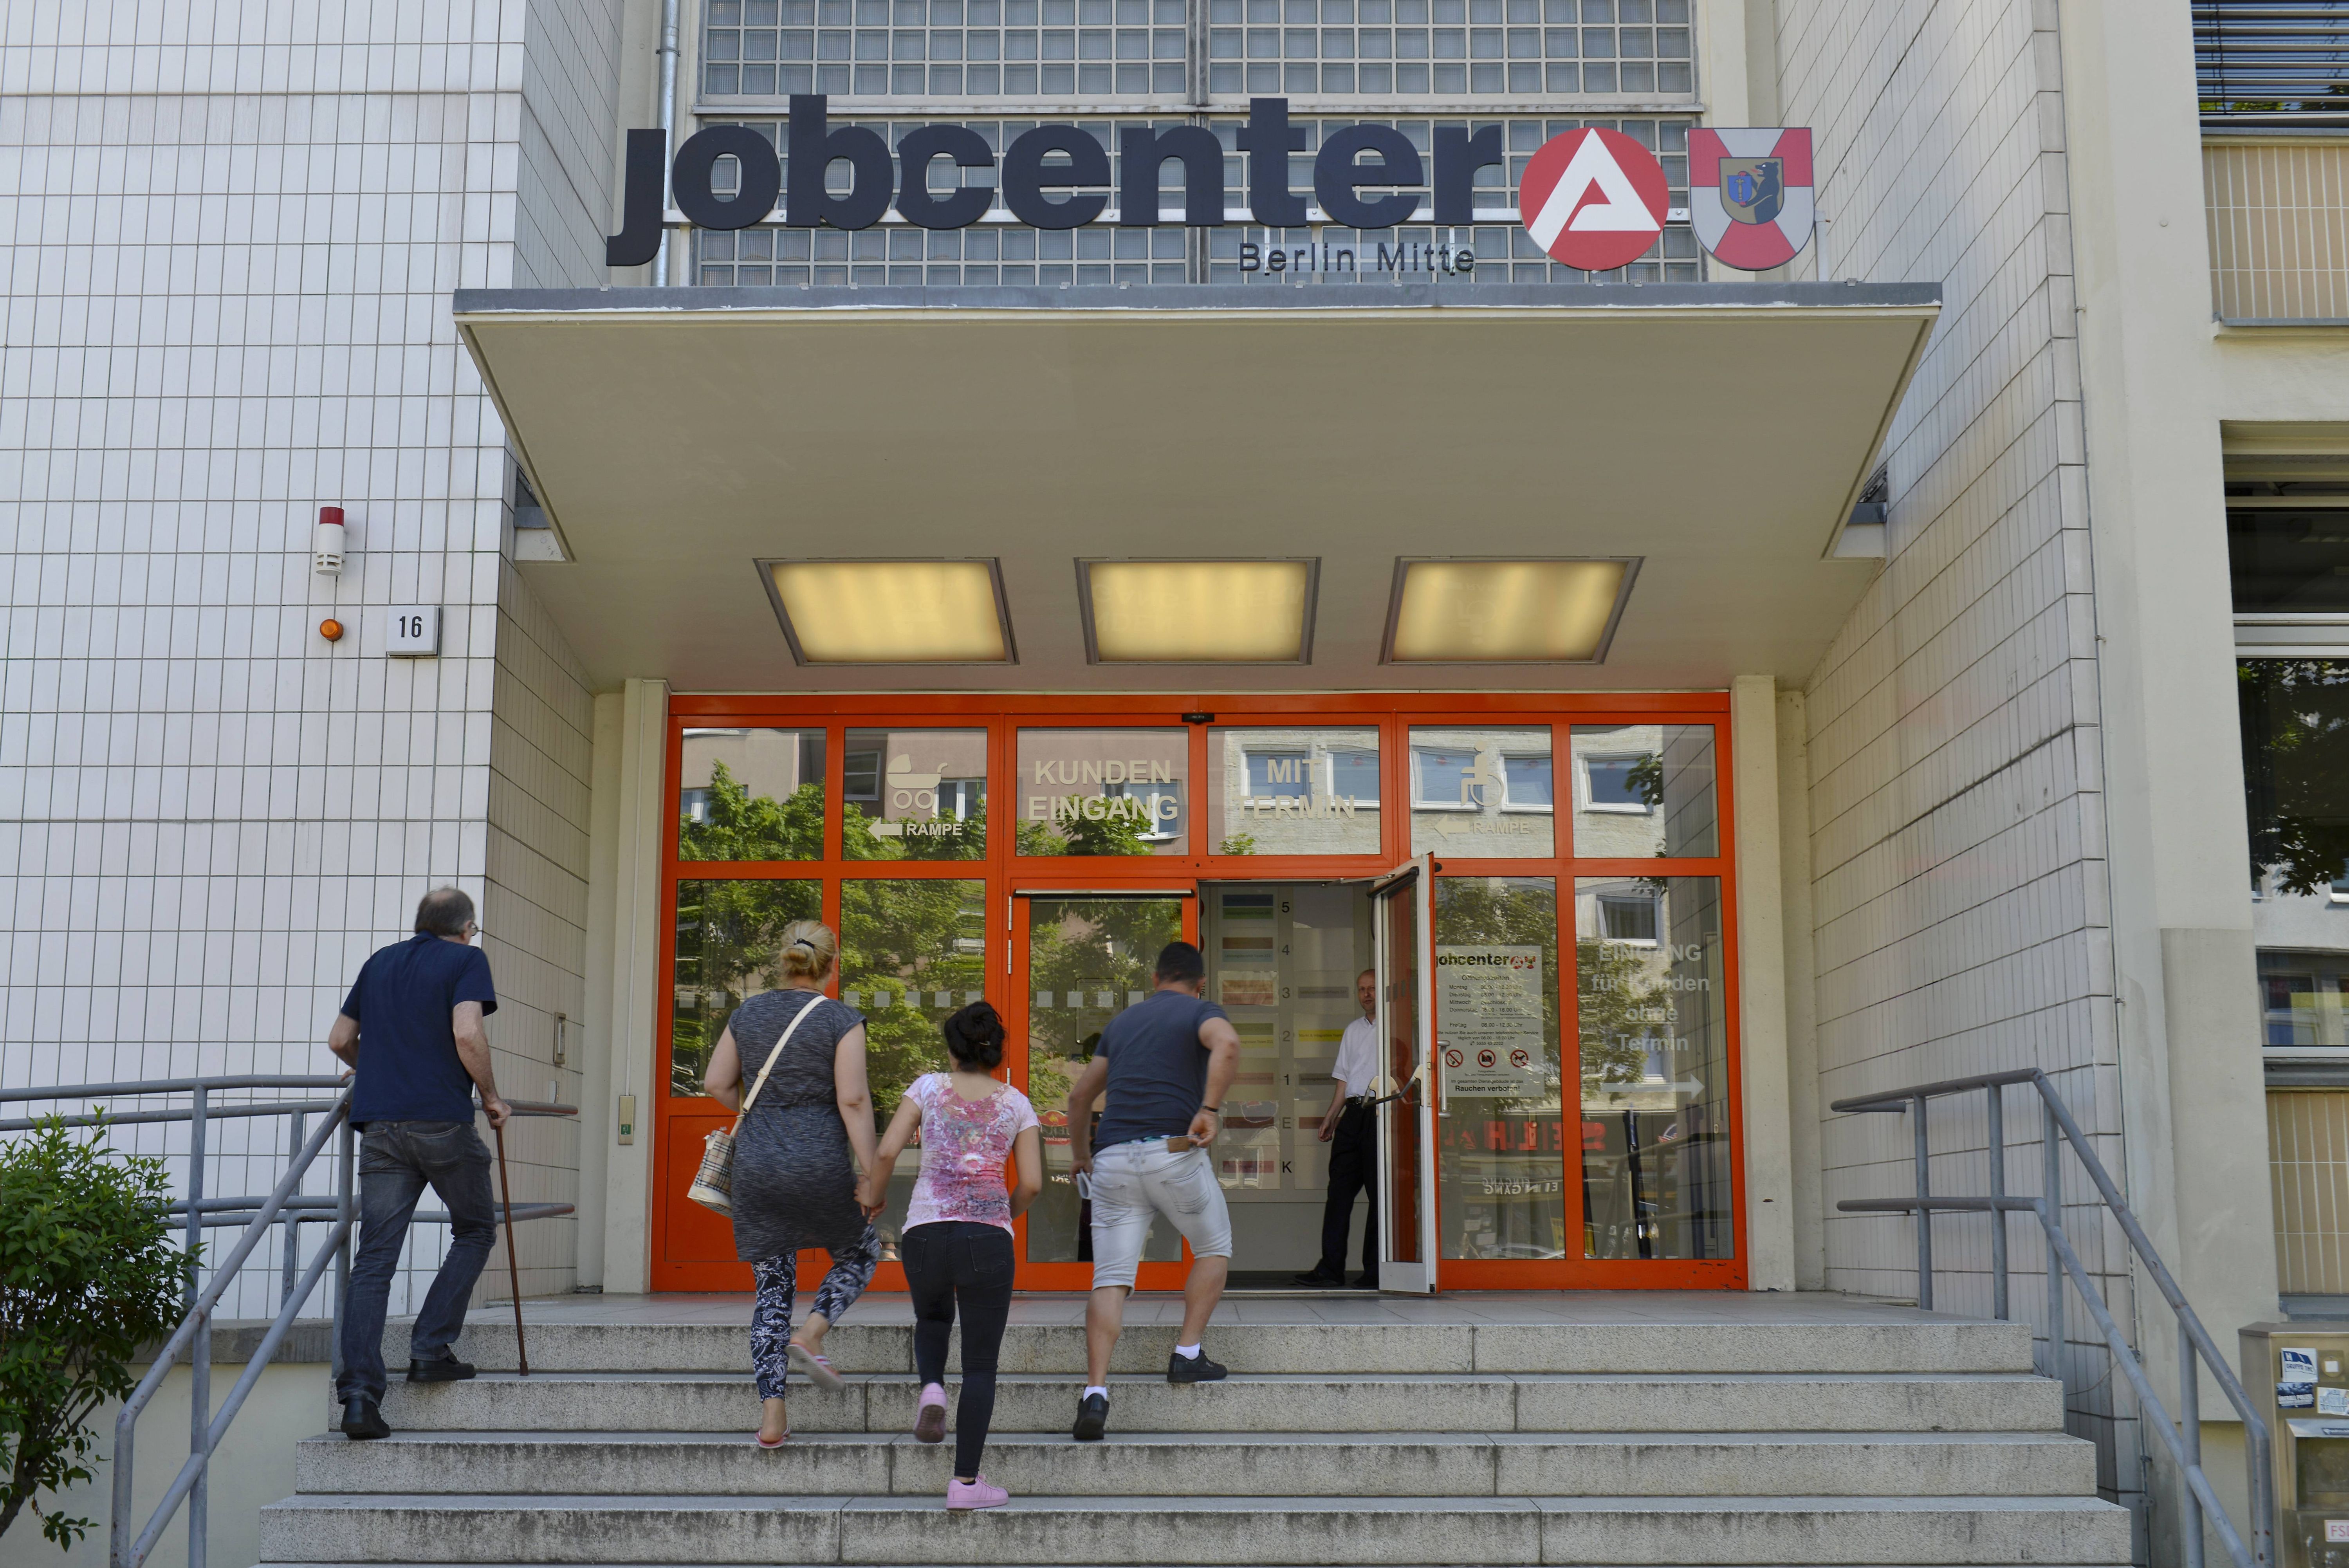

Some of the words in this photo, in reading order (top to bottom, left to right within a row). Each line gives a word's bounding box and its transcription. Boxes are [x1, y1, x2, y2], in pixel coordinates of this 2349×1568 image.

[606, 94, 1502, 266] jobcenter
[1239, 242, 1355, 271] Berlin
[1378, 242, 1475, 275] Mitte
[399, 616, 422, 638] 16
[1035, 760, 1171, 785] KUNDEN
[1267, 759, 1321, 784] MIT
[1029, 795, 1178, 821] EINGANG
[1238, 794, 1355, 819] TERMIN
[906, 823, 962, 836] RAMPE
[1472, 821, 1530, 834] RAMPE
[1281, 902, 1290, 913] 5
[1281, 944, 1290, 955] 4
[1599, 944, 1701, 962] EINGANG
[1591, 974, 1621, 992] für
[1282, 987, 1290, 998] 3
[1625, 1003, 1678, 1021] ohne
[1282, 1030, 1290, 1042] 2
[1616, 1033, 1689, 1051] Termin
[1284, 1074, 1289, 1085] 1
[1282, 1117, 1291, 1129] E
[1282, 1161, 1292, 1173] K
